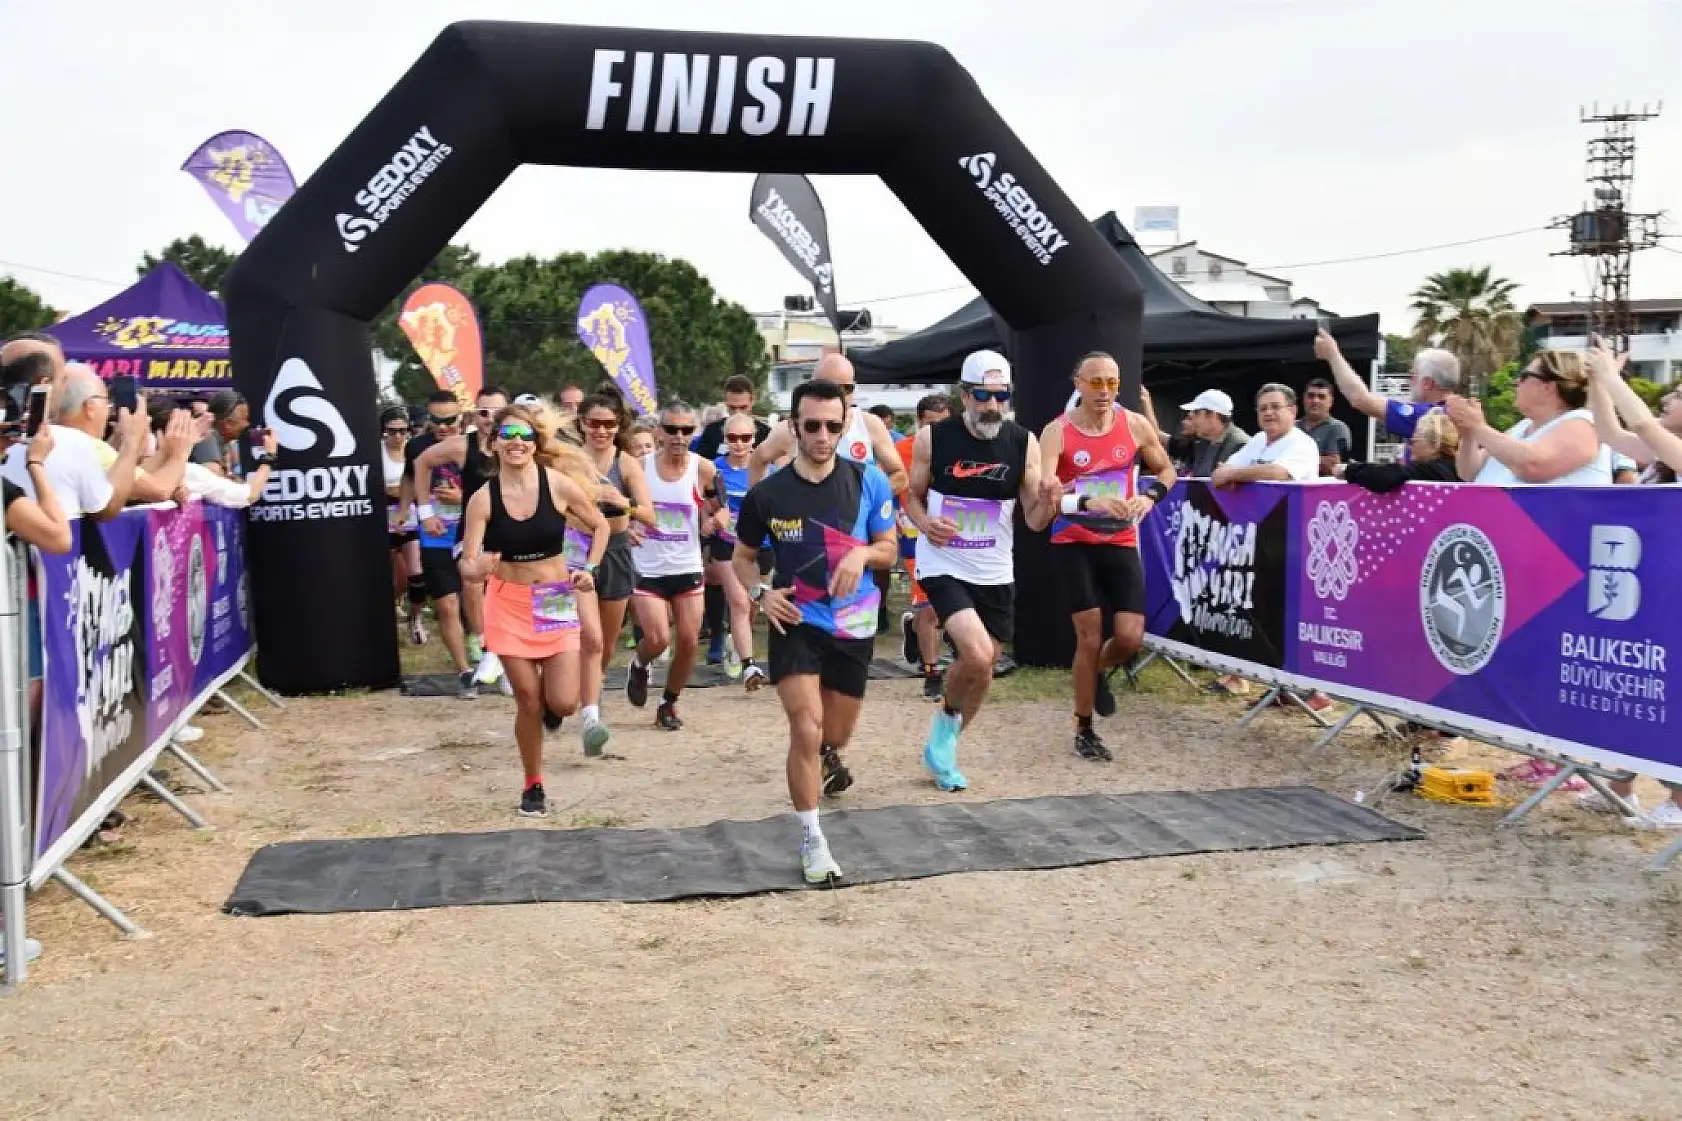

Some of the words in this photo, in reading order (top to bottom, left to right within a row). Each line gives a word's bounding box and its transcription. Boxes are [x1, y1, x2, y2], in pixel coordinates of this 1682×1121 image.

[585, 48, 835, 136] FINISH
[355, 125, 439, 214] SEDOXY
[373, 181, 416, 223] SPORTS
[983, 186, 1022, 228] SPORTS
[993, 172, 1069, 254] SEDOXY
[146, 359, 233, 379] MARAT
[249, 504, 305, 521] SPORTS
[1560, 631, 1666, 673] BALIKESİR
[1559, 661, 1666, 702] BÜYÜKŞEHİR
[1558, 689, 1667, 724] BELEDİYESİ
